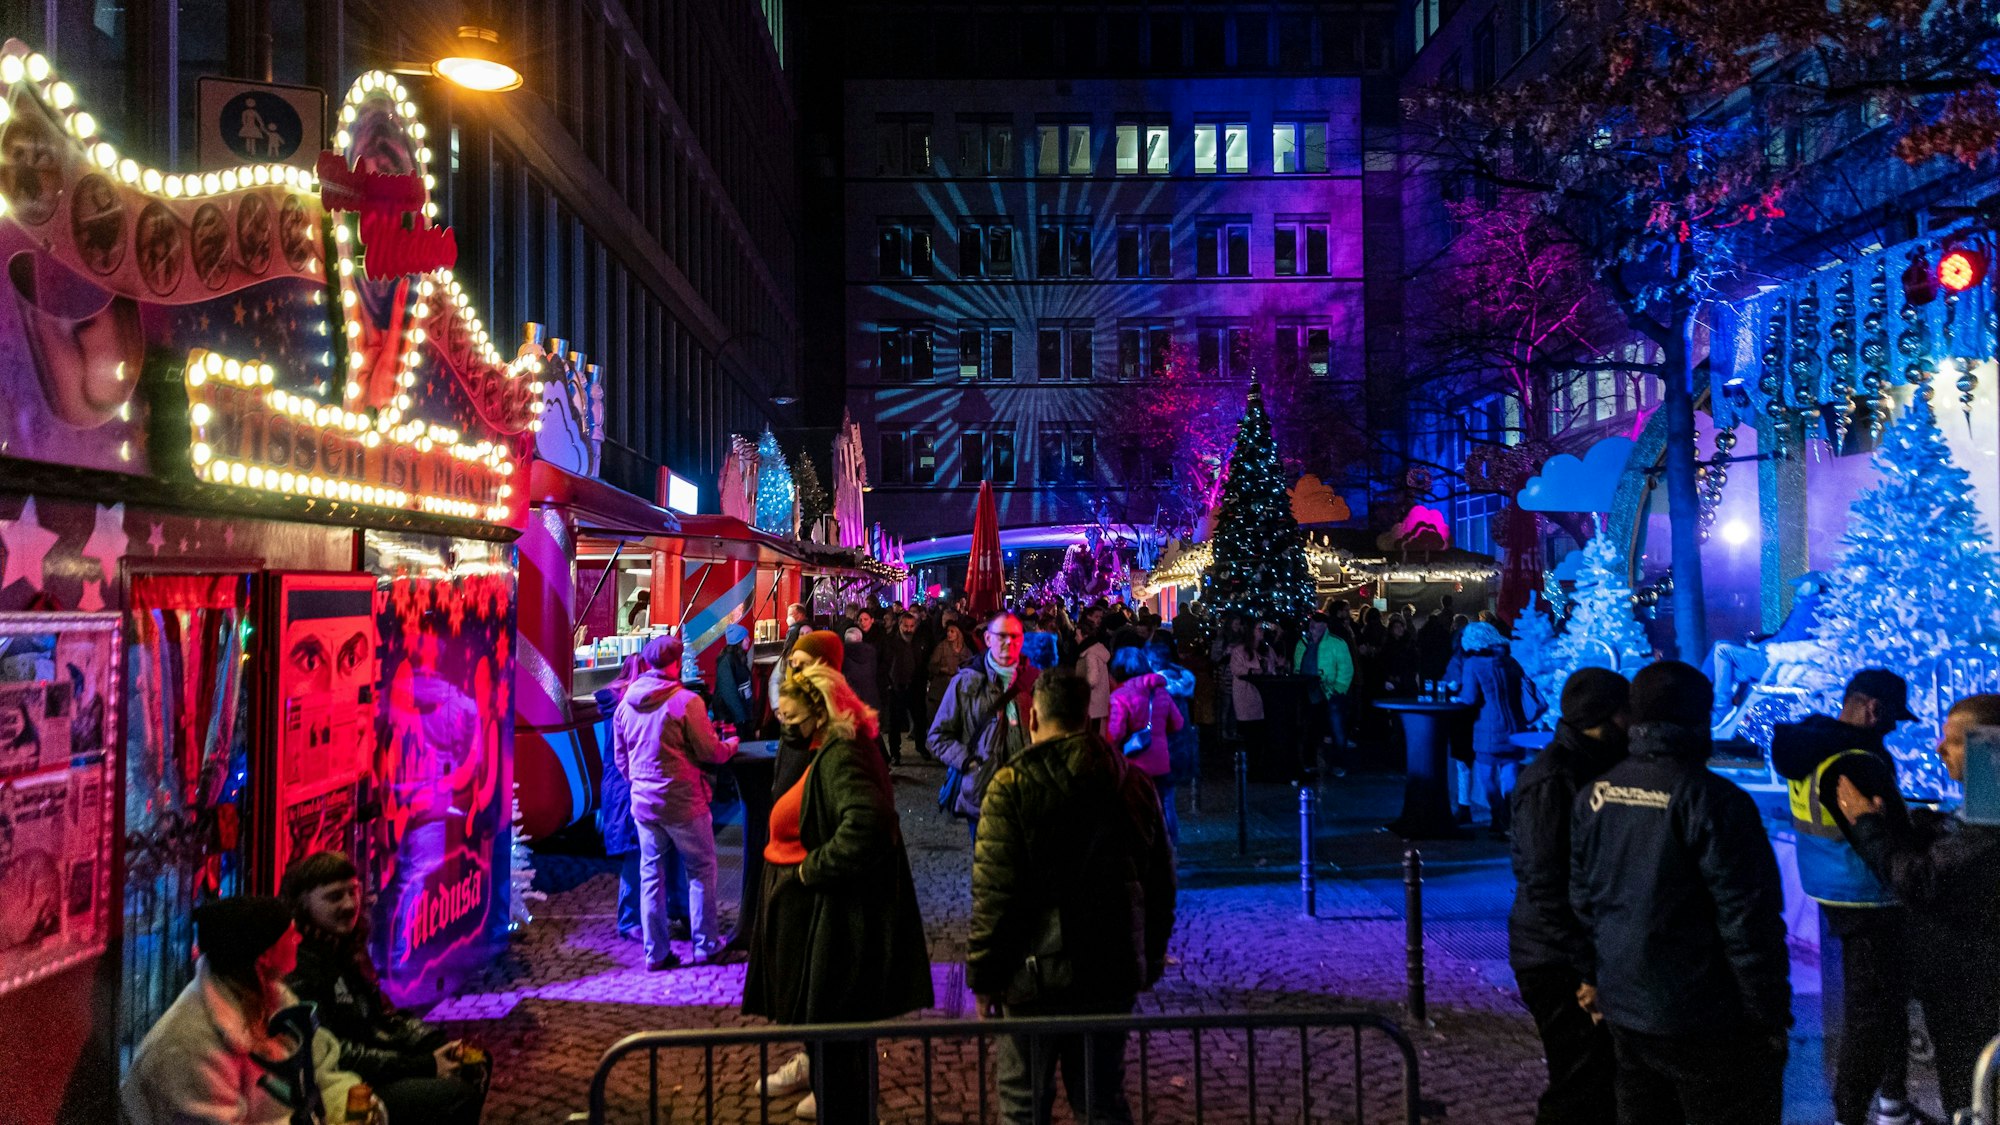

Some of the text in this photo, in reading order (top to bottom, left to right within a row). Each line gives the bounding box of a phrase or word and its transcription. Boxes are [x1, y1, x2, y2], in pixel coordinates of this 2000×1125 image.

[204, 381, 366, 481] Wissen
[382, 442, 421, 492] ist
[400, 870, 481, 966] Medusa
